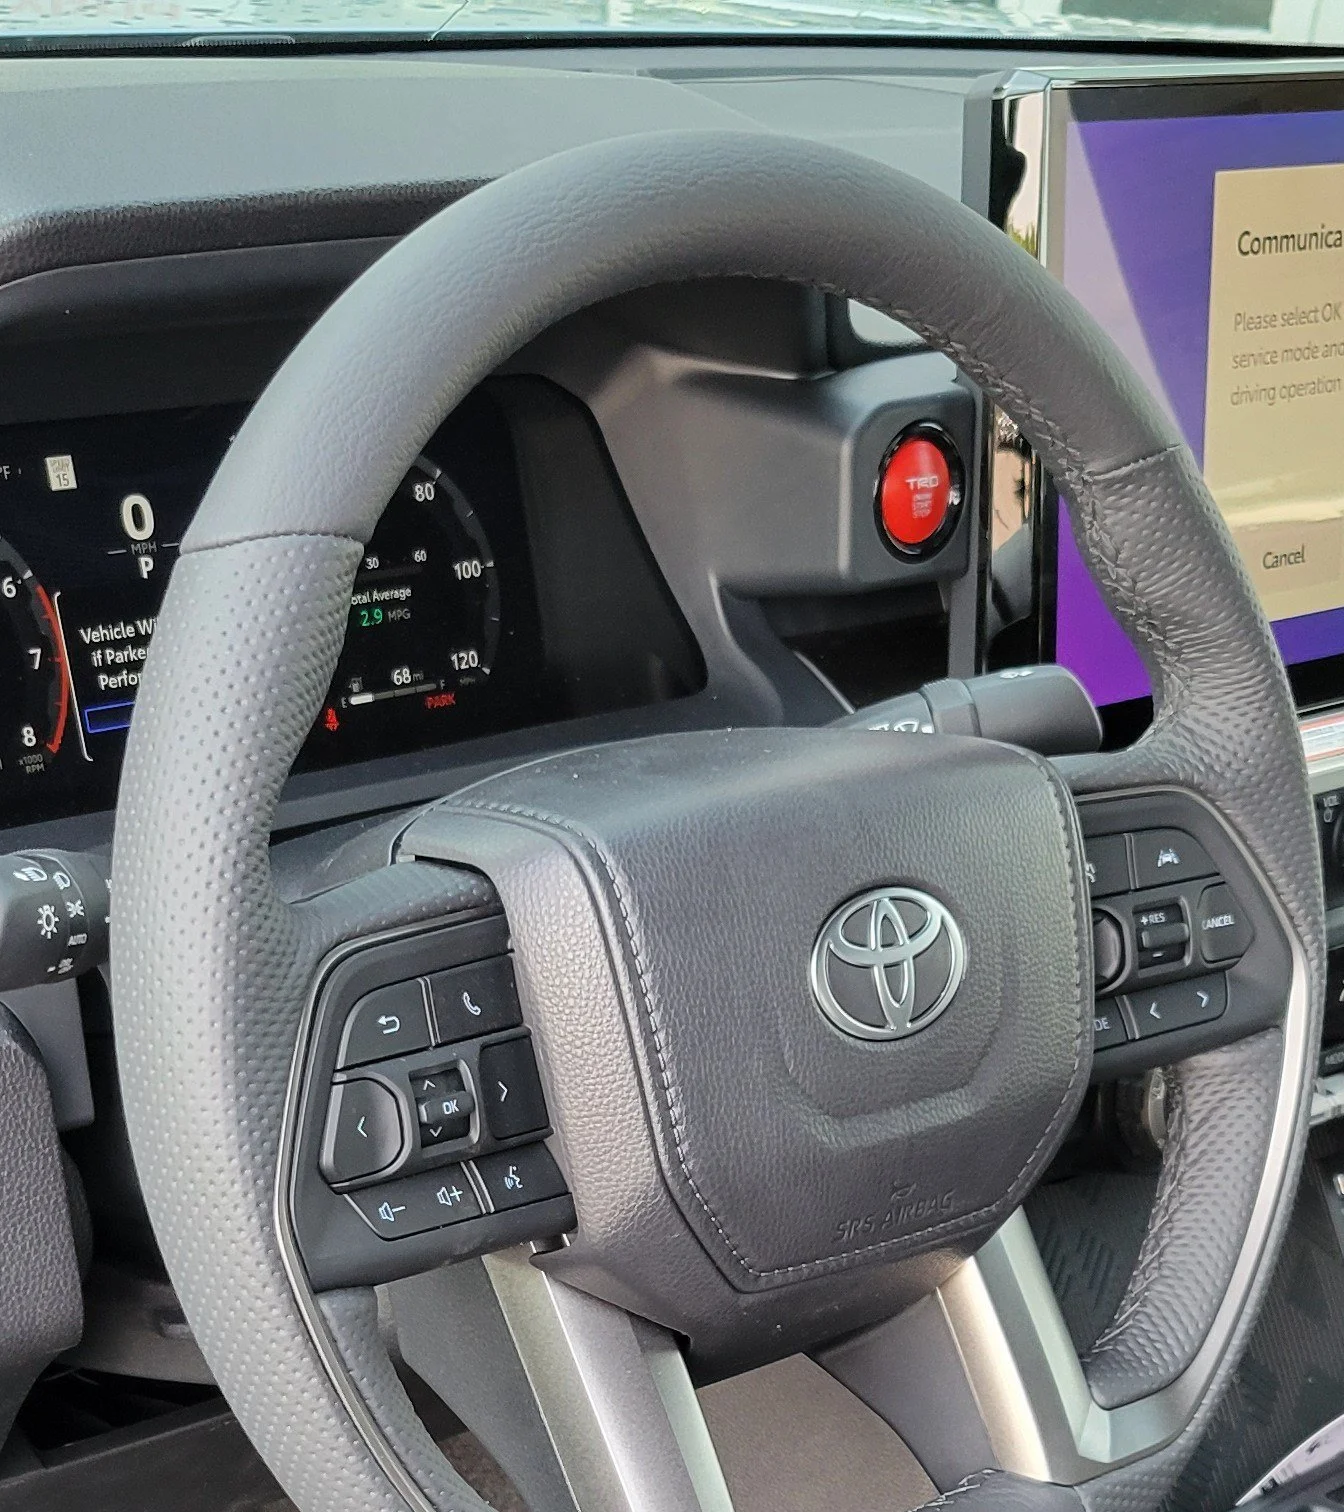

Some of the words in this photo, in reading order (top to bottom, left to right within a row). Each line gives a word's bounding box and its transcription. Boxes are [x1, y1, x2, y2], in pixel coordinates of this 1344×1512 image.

[1234, 312, 1277, 332] Please
[1280, 306, 1320, 327] select
[1321, 302, 1342, 323] OK
[1232, 350, 1279, 369] service
[1281, 341, 1319, 363] mode
[1230, 384, 1276, 406] driving
[1279, 376, 1343, 402] operation
[56, 473, 70, 487] 15
[905, 475, 939, 490] TRD
[413, 483, 435, 502] 80
[120, 494, 154, 541] 0
[131, 543, 157, 555] MPH
[414, 549, 427, 563] 60
[1262, 545, 1306, 570] Cancel
[139, 557, 154, 579] P
[365, 557, 380, 570] 30
[454, 560, 483, 581] 100
[1, 577, 16, 598] 6
[350, 592, 371, 606] otal
[372, 587, 412, 604] Average
[361, 608, 383, 627] 2.9
[387, 609, 411, 622] MPG
[79, 620, 135, 644] Vehicle
[28, 648, 42, 670] 7
[92, 650, 103, 667] if
[106, 645, 147, 665] Parke
[450, 651, 479, 671] 120
[393, 668, 412, 686] 68
[21, 726, 37, 747] 8
[25, 763, 45, 775] RPM
[1202, 914, 1235, 930] CANCEL
[67, 933, 88, 947] AUTO
[1093, 1017, 1111, 1032] DE
[443, 1099, 460, 1115] OK
